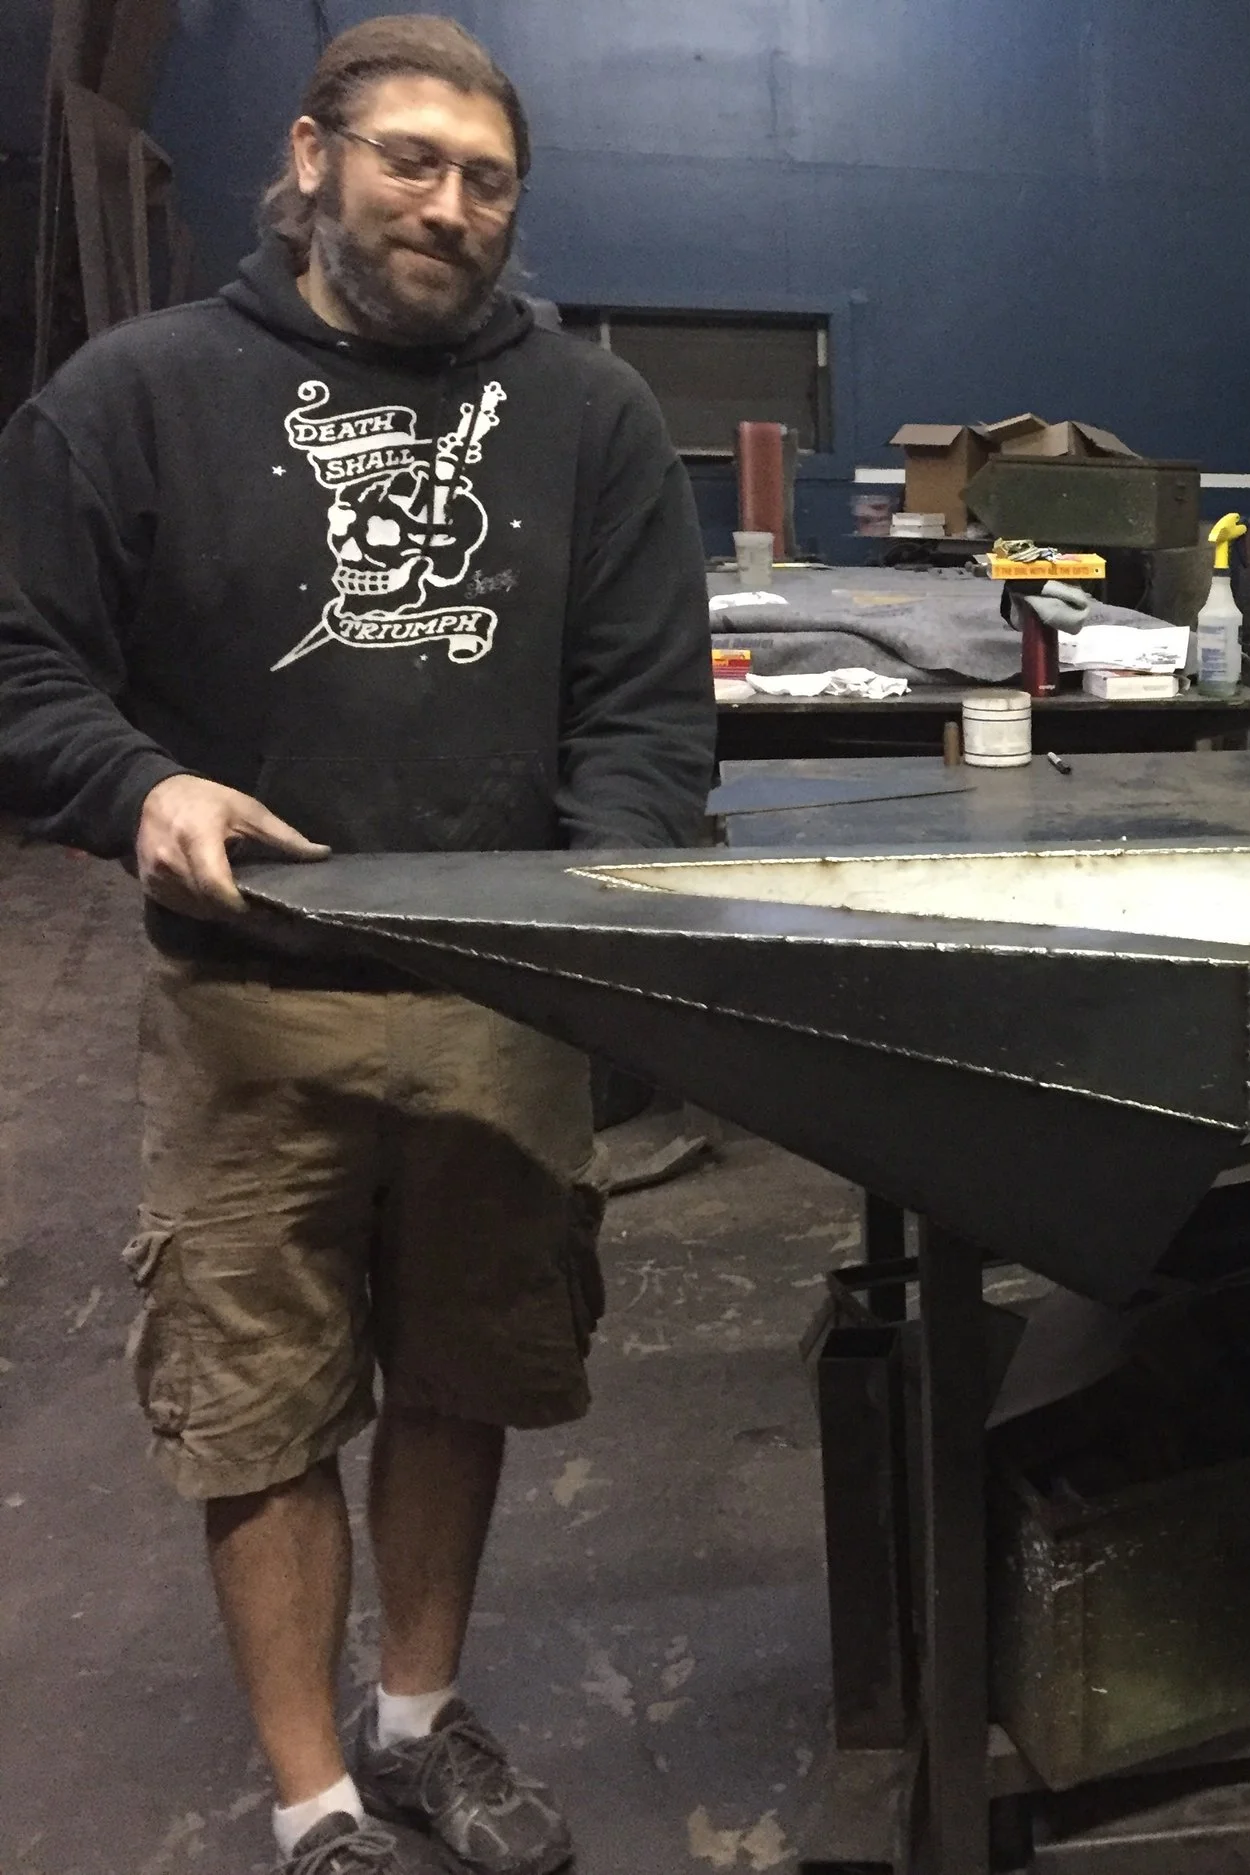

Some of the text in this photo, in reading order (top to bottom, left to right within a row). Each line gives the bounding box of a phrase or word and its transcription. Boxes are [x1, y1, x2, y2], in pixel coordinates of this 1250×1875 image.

[294, 412, 396, 442] DEATH
[326, 448, 415, 481] SHALL
[338, 612, 483, 640] TRIUMPH
